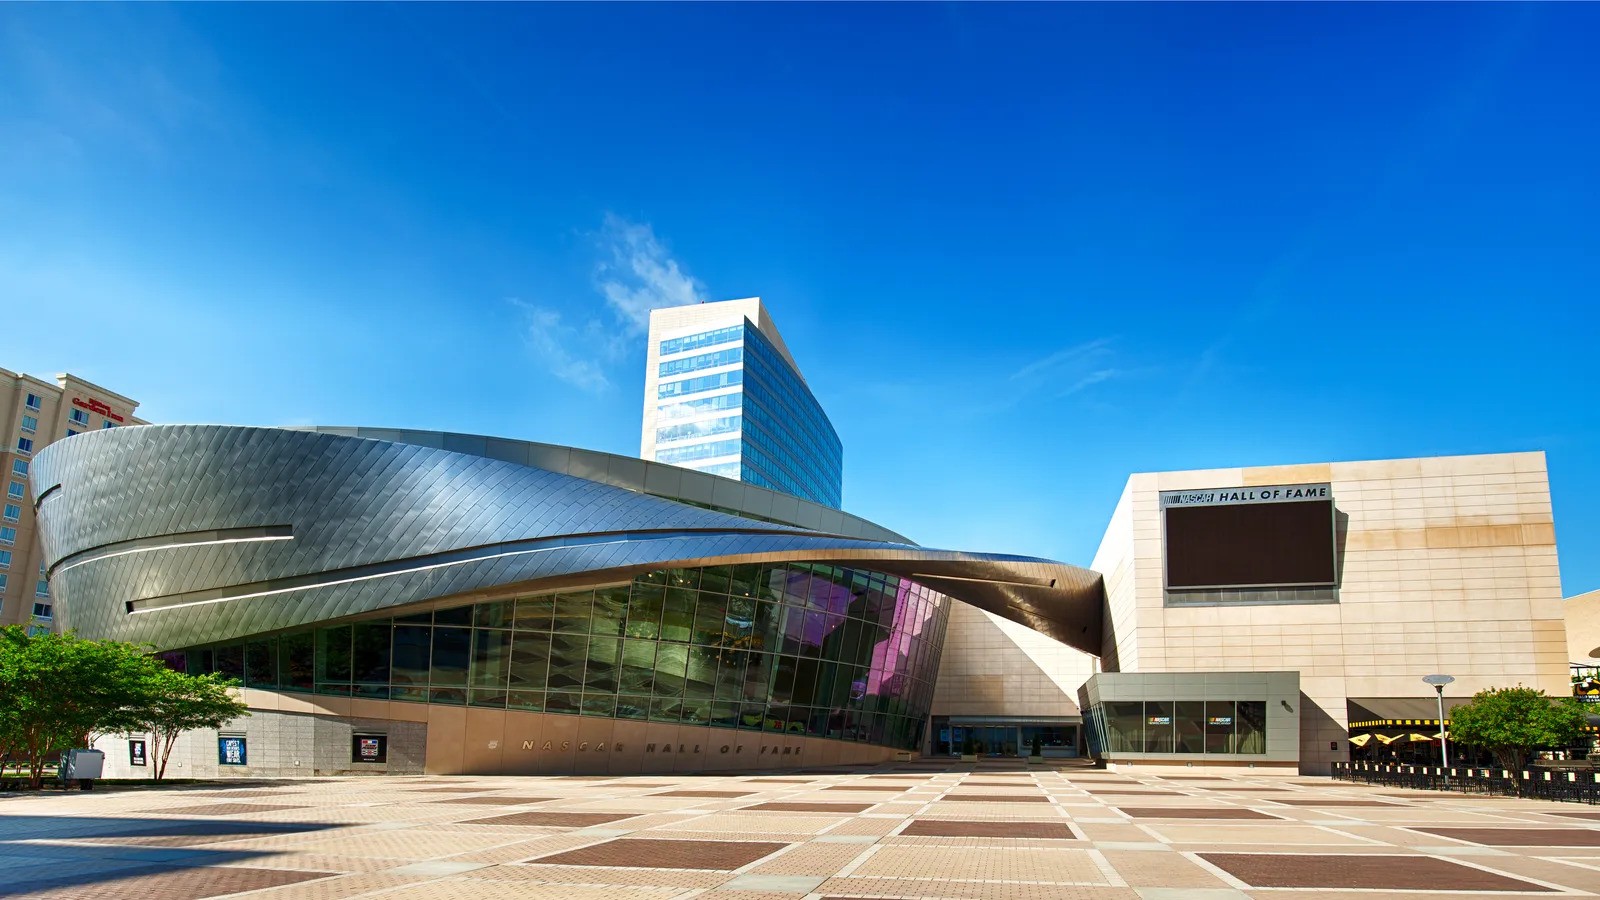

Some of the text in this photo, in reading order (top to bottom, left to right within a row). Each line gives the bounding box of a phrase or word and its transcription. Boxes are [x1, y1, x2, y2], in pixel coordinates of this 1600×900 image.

[1178, 488, 1327, 504] NASCAR HALL OF FAME
[522, 739, 802, 756] NASCAR HALL OF FAME
